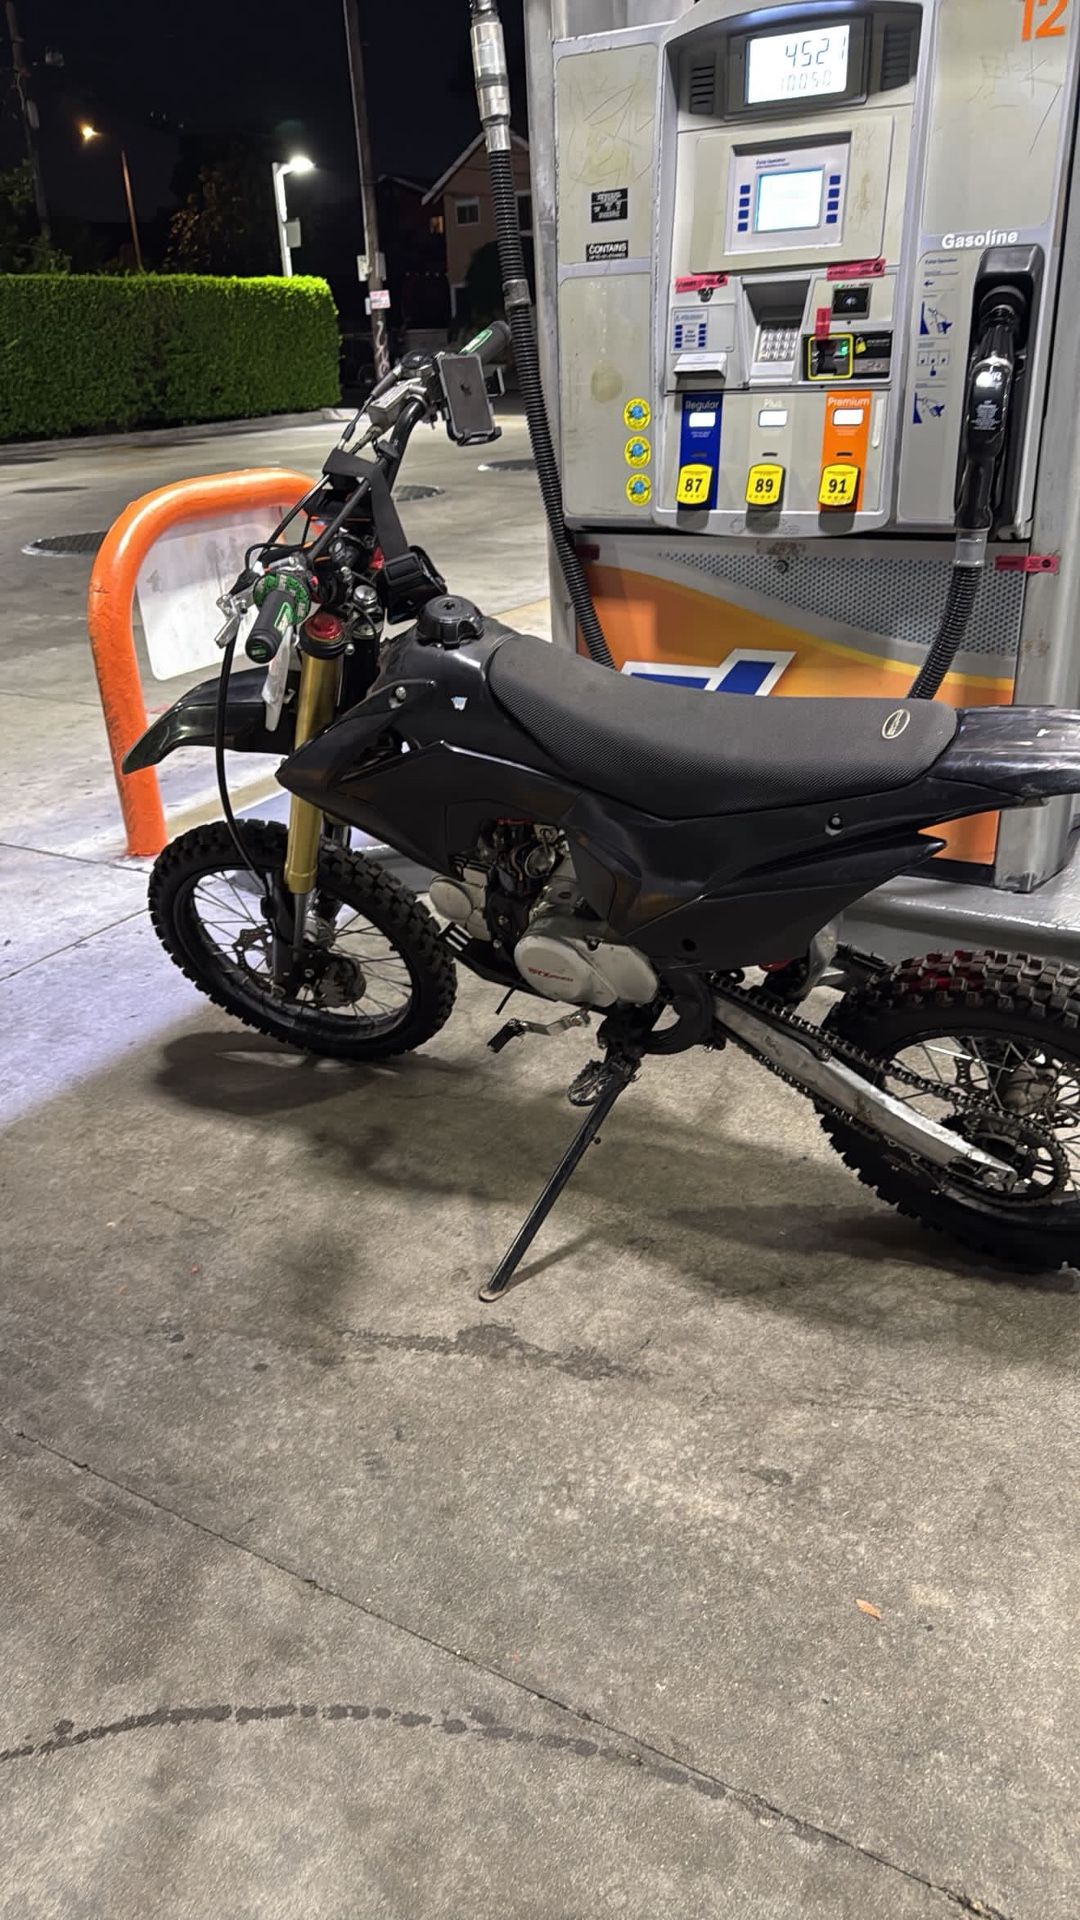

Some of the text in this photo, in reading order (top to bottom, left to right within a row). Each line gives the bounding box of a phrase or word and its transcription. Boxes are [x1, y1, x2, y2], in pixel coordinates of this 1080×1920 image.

[1022, 0, 1067, 42] 12
[941, 230, 1018, 249] Gasoline
[588, 243, 627, 254] CONTAINS
[685, 400, 720, 411] Regular
[828, 397, 870, 407] Premium
[684, 478, 702, 493] 87
[754, 478, 774, 493] 89
[828, 478, 847, 494] 91
